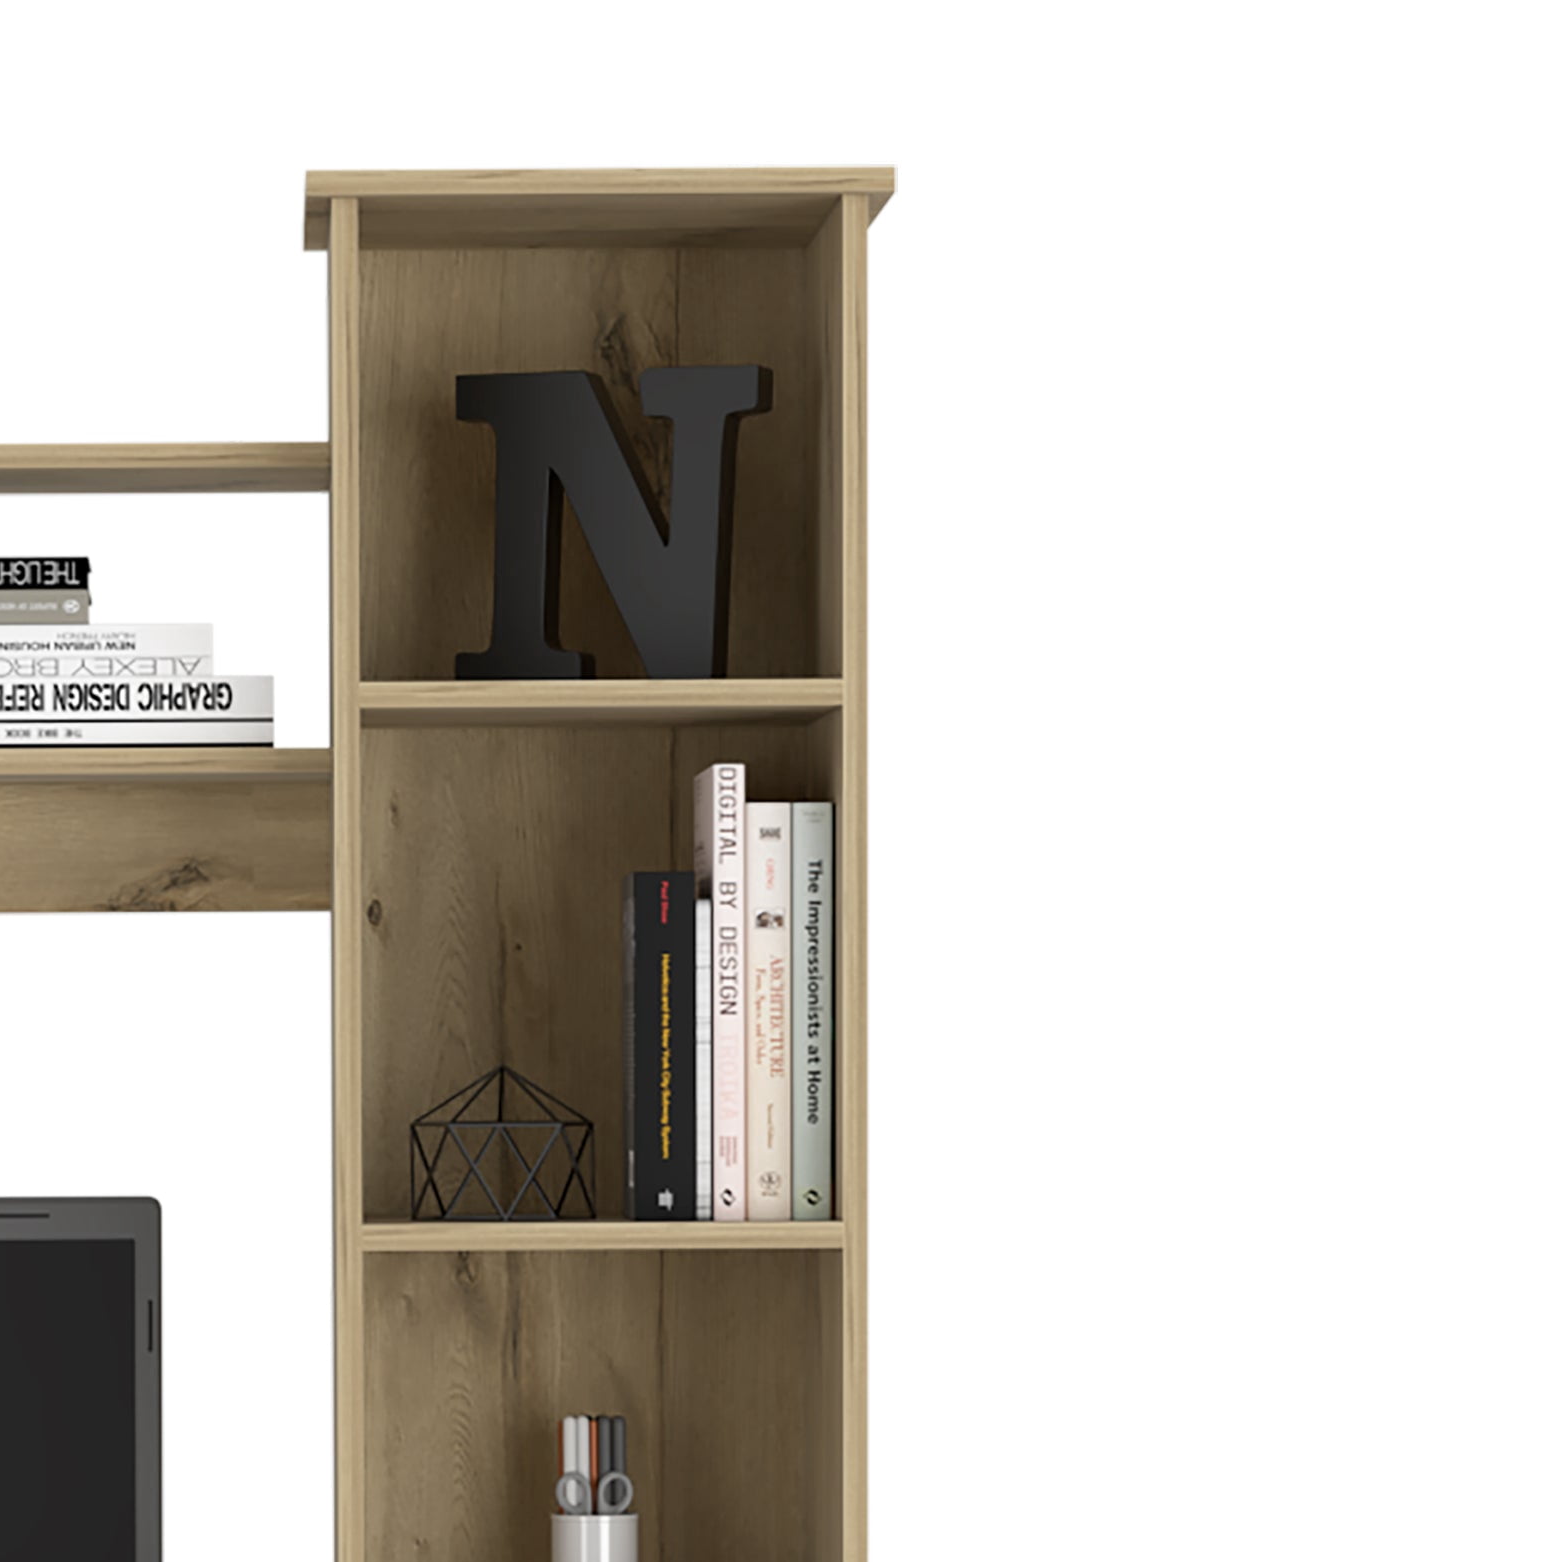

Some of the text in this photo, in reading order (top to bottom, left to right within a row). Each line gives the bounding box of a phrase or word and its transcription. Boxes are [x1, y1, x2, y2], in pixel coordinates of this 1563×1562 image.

[455, 364, 773, 680] N
[44, 561, 79, 585] THE
[106, 641, 135, 651] NEW
[69, 657, 202, 677] ALEXEY
[53, 683, 130, 711] DESIGN
[137, 682, 233, 711] GRAPHIC
[718, 767, 737, 865] DIGITAL
[718, 881, 737, 909] BY
[718, 926, 737, 1015] DESIGN
[804, 860, 823, 1125] The Impressionists at Home
[769, 956, 785, 1078] ARCHITECTURE
